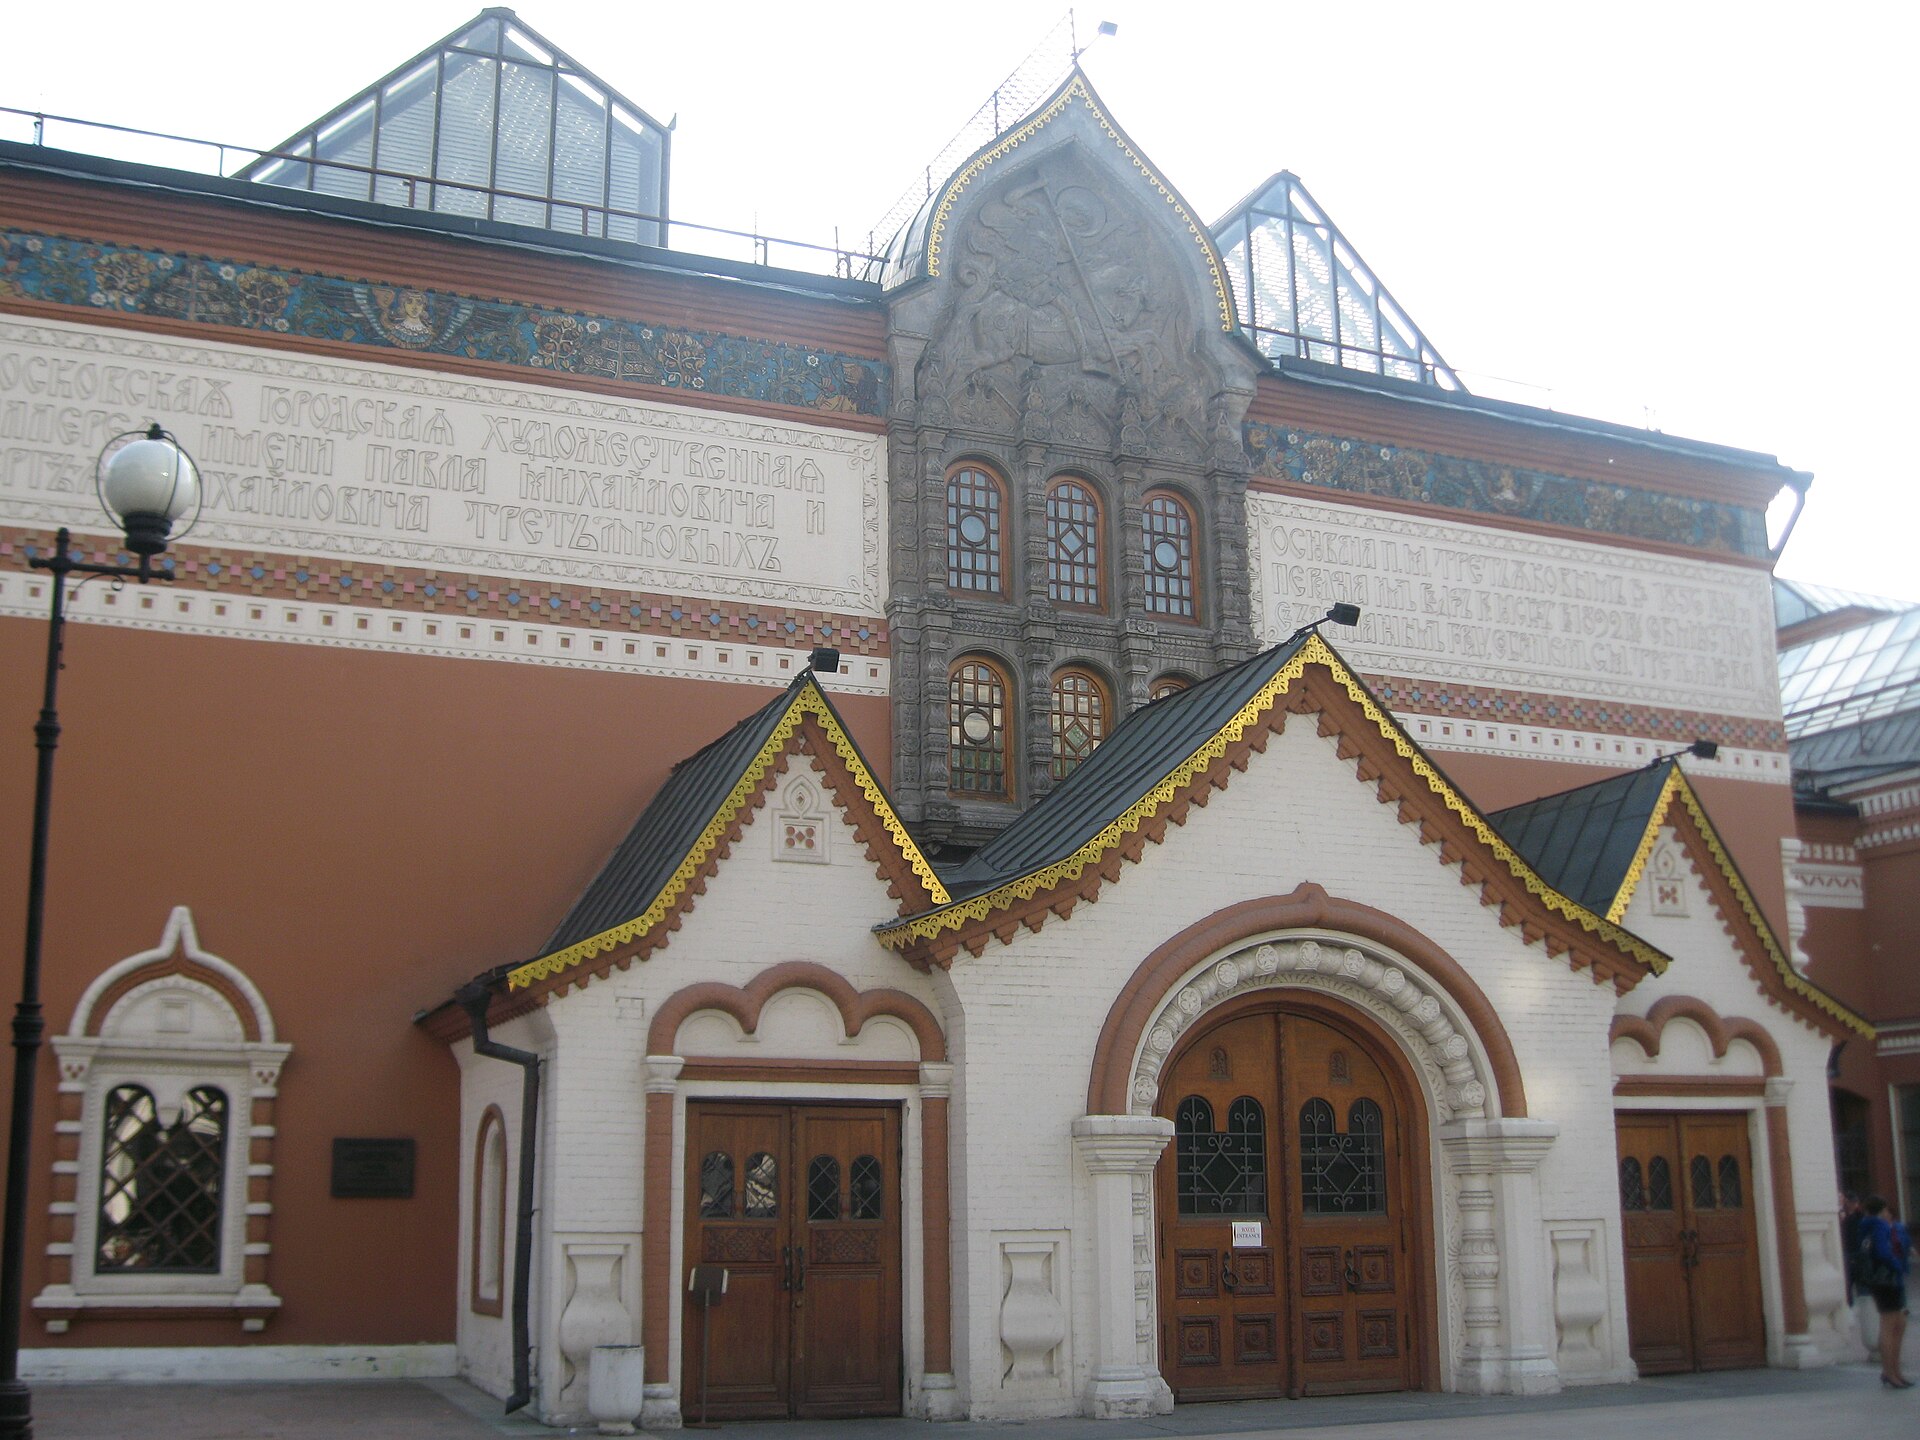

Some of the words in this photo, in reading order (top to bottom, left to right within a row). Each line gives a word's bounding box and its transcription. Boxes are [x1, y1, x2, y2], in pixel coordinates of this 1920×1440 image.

[200, 423, 334, 476] ИМЕНИ
[365, 443, 487, 495] ПАВЛА
[806, 499, 825, 535] И
